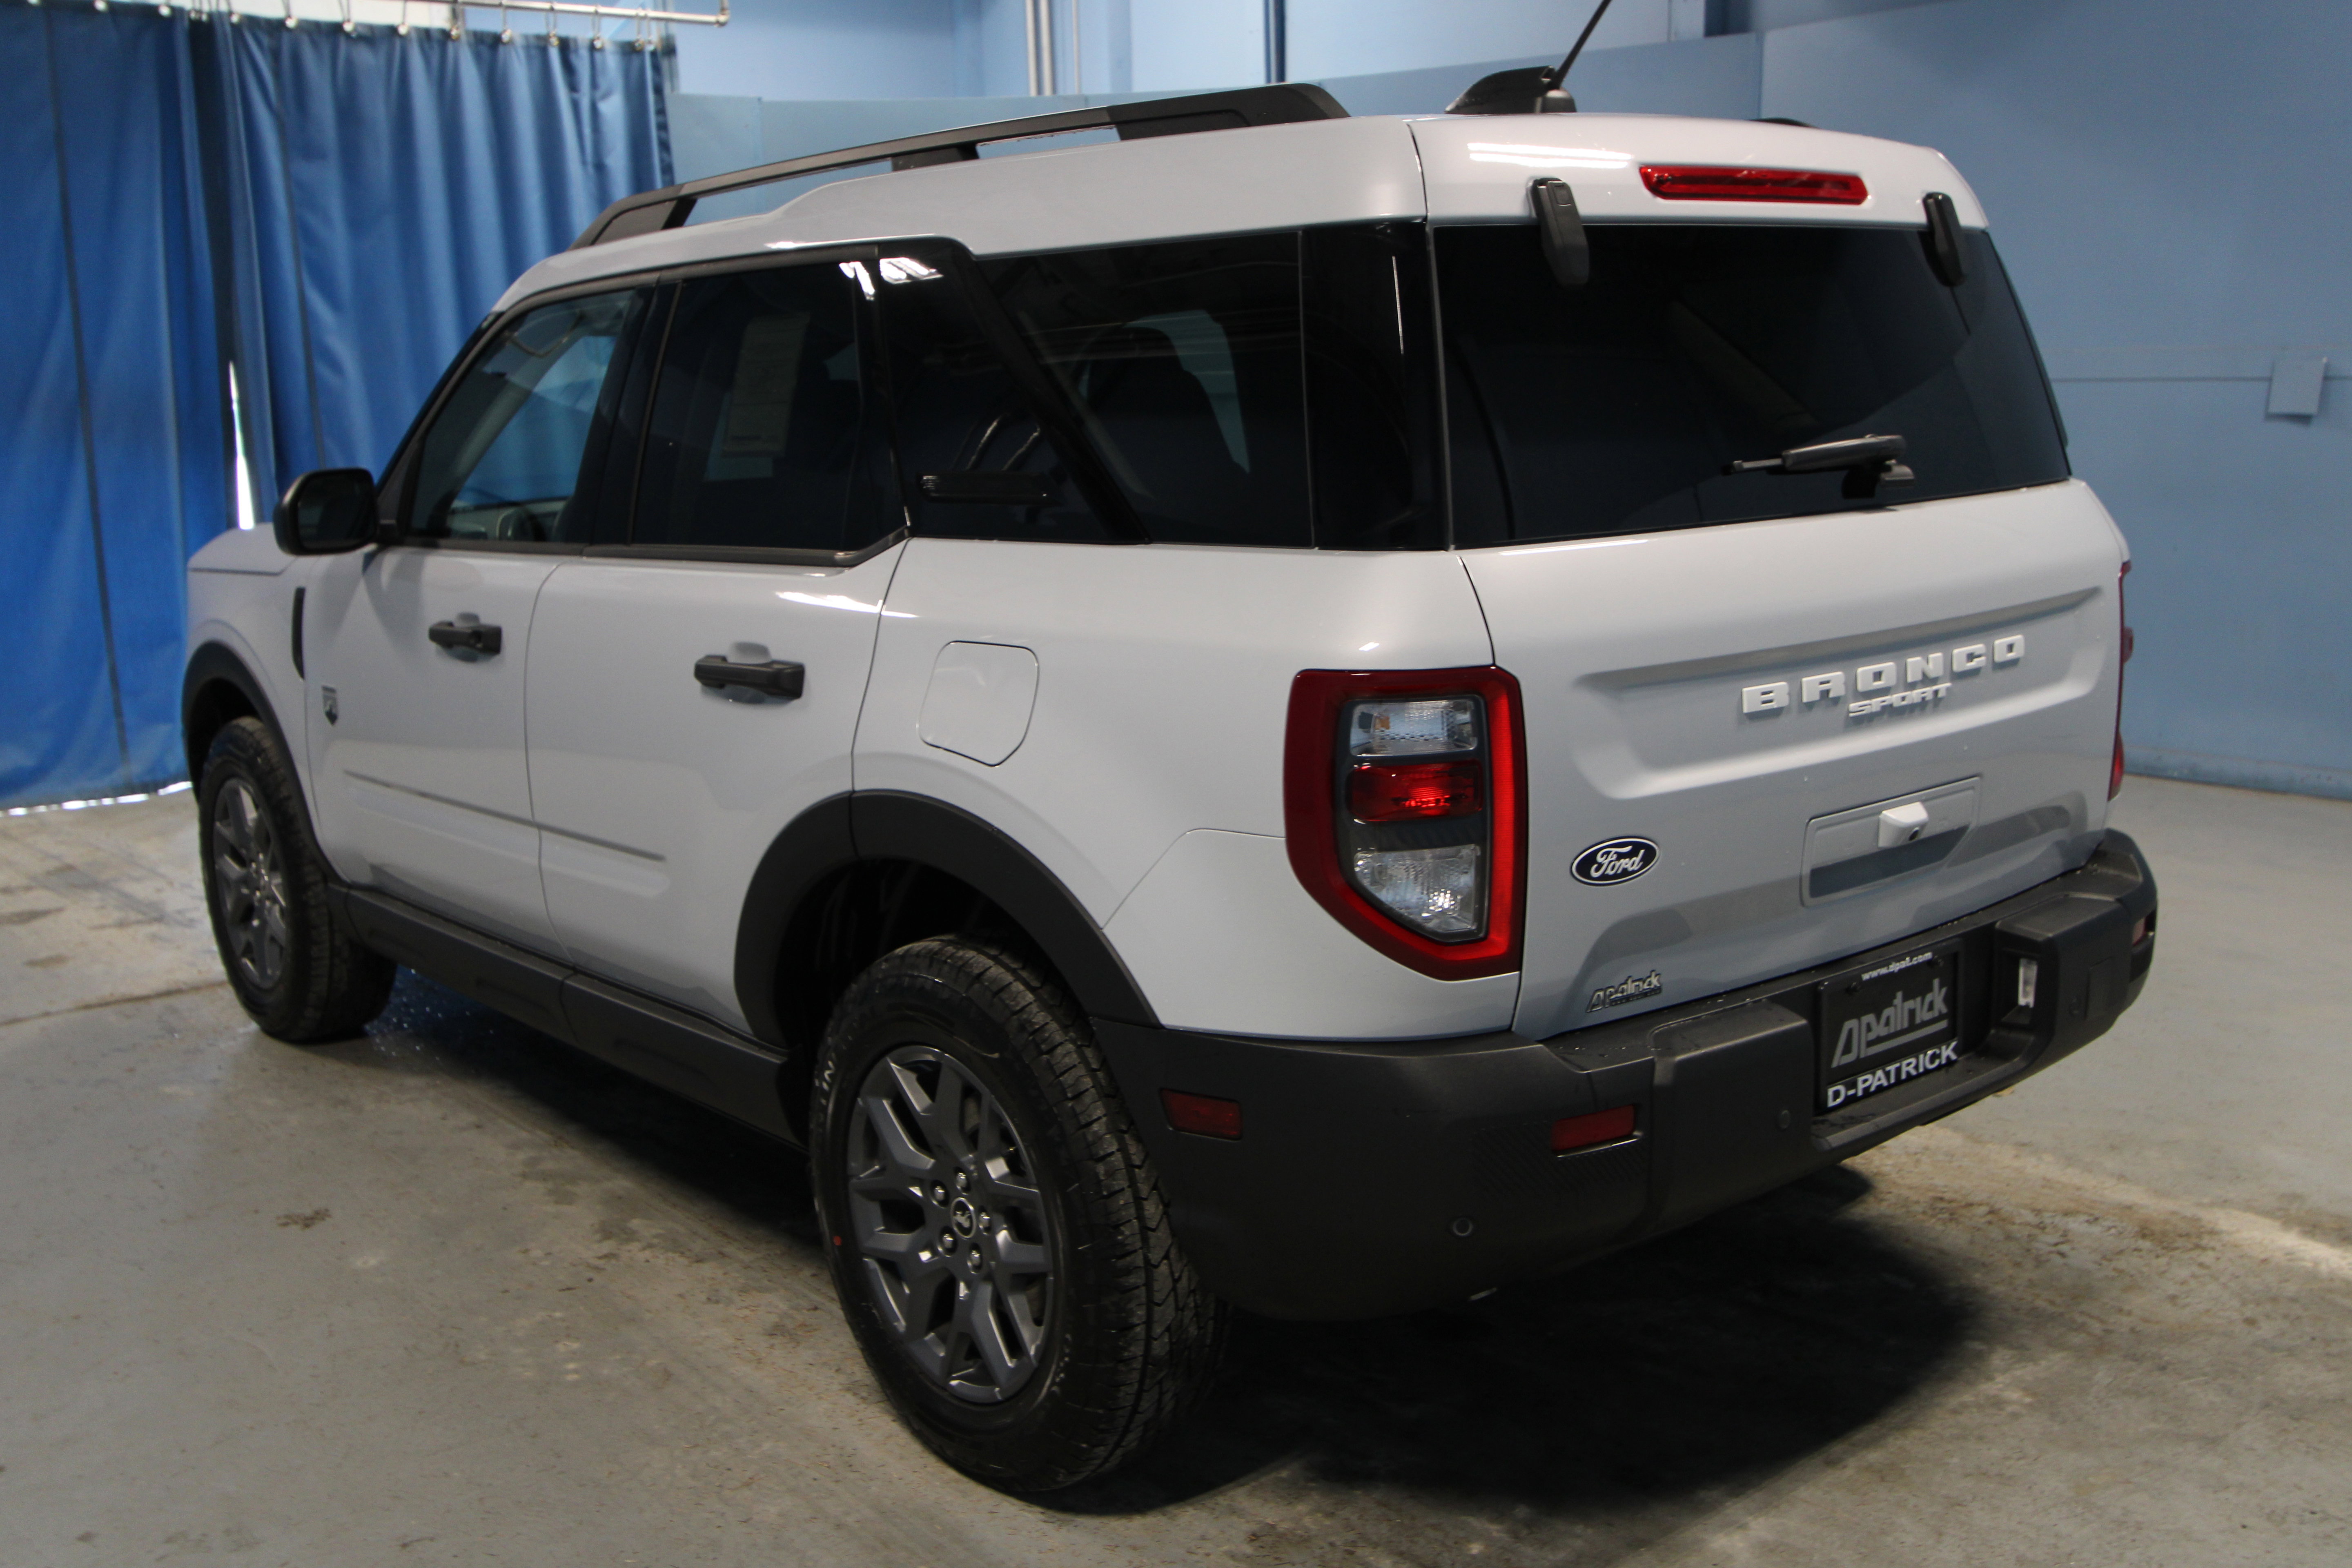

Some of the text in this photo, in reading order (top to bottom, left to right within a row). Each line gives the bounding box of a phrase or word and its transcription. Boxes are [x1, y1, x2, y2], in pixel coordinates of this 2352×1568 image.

[1742, 634, 2025, 714] BRONCO
[1848, 682, 1953, 717] SPORT
[1590, 845, 1645, 878] Ford
[1826, 1041, 1958, 1108] D-PATRICK
